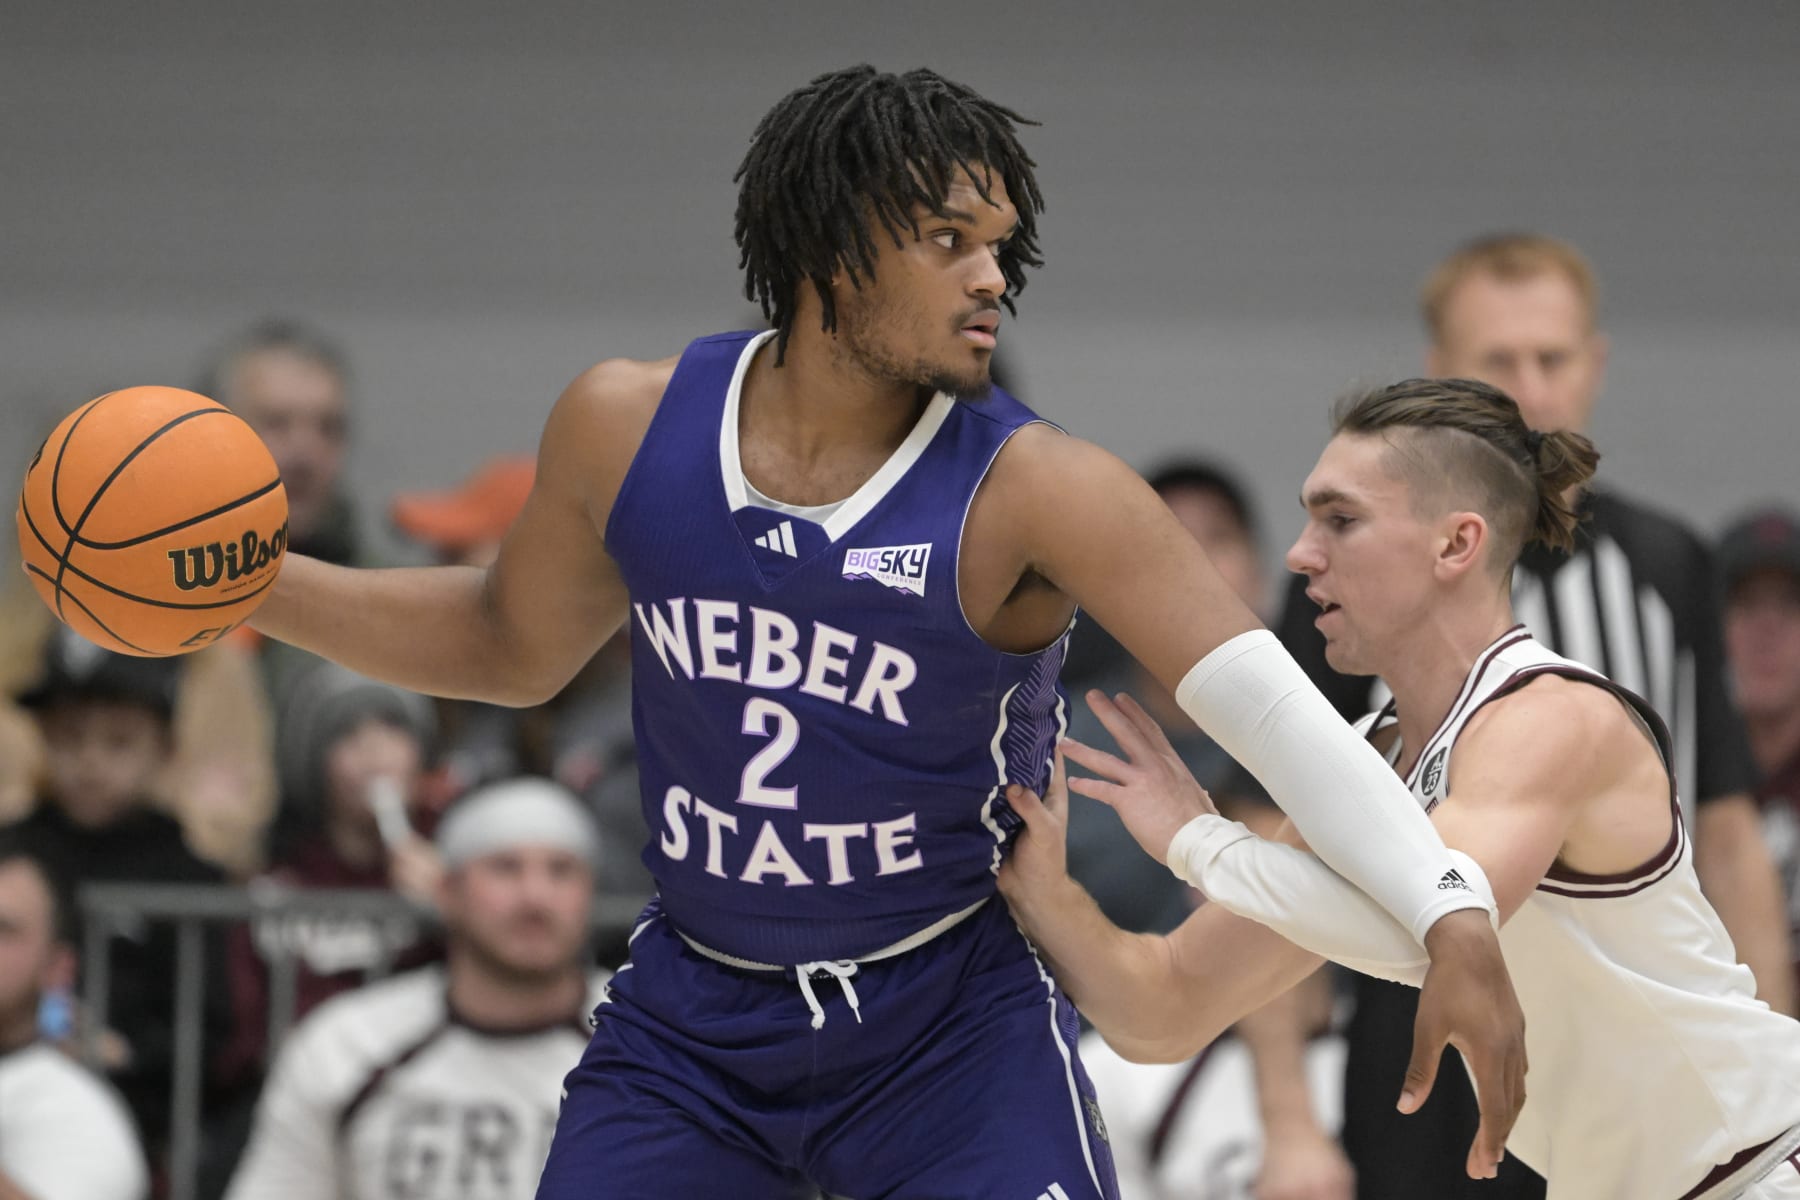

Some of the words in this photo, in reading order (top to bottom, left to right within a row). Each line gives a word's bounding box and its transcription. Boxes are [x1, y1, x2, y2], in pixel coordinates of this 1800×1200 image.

[633, 597, 918, 727] WEBER
[735, 696, 800, 810] 2
[660, 784, 924, 888] STATE
